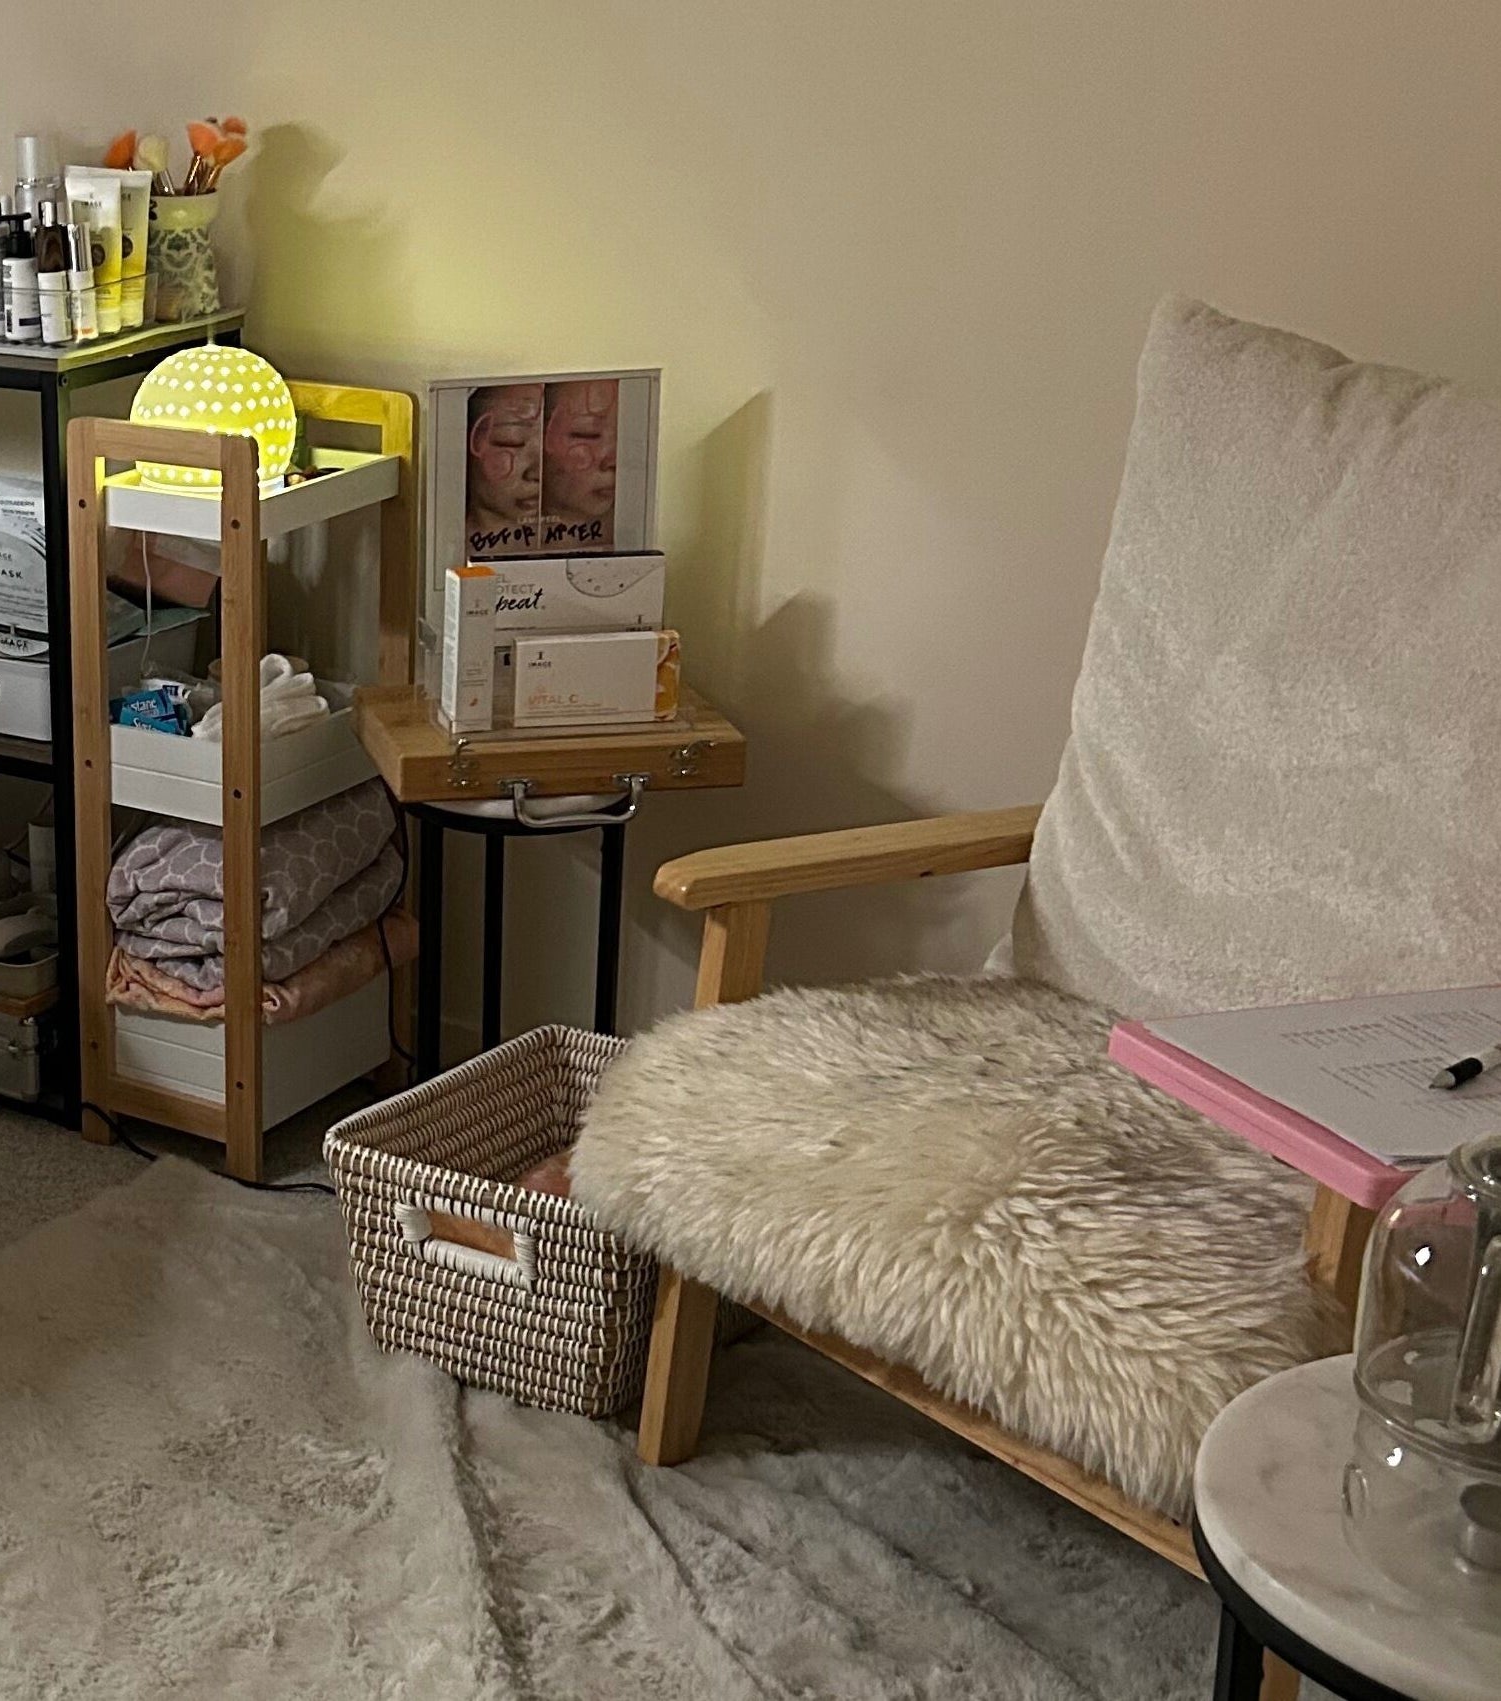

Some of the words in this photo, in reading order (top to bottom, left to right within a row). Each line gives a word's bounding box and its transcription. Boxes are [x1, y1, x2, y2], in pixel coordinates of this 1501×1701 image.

[465, 608, 489, 616] IMAGE
[528, 694, 562, 705] VITAL
[568, 694, 579, 704] C
